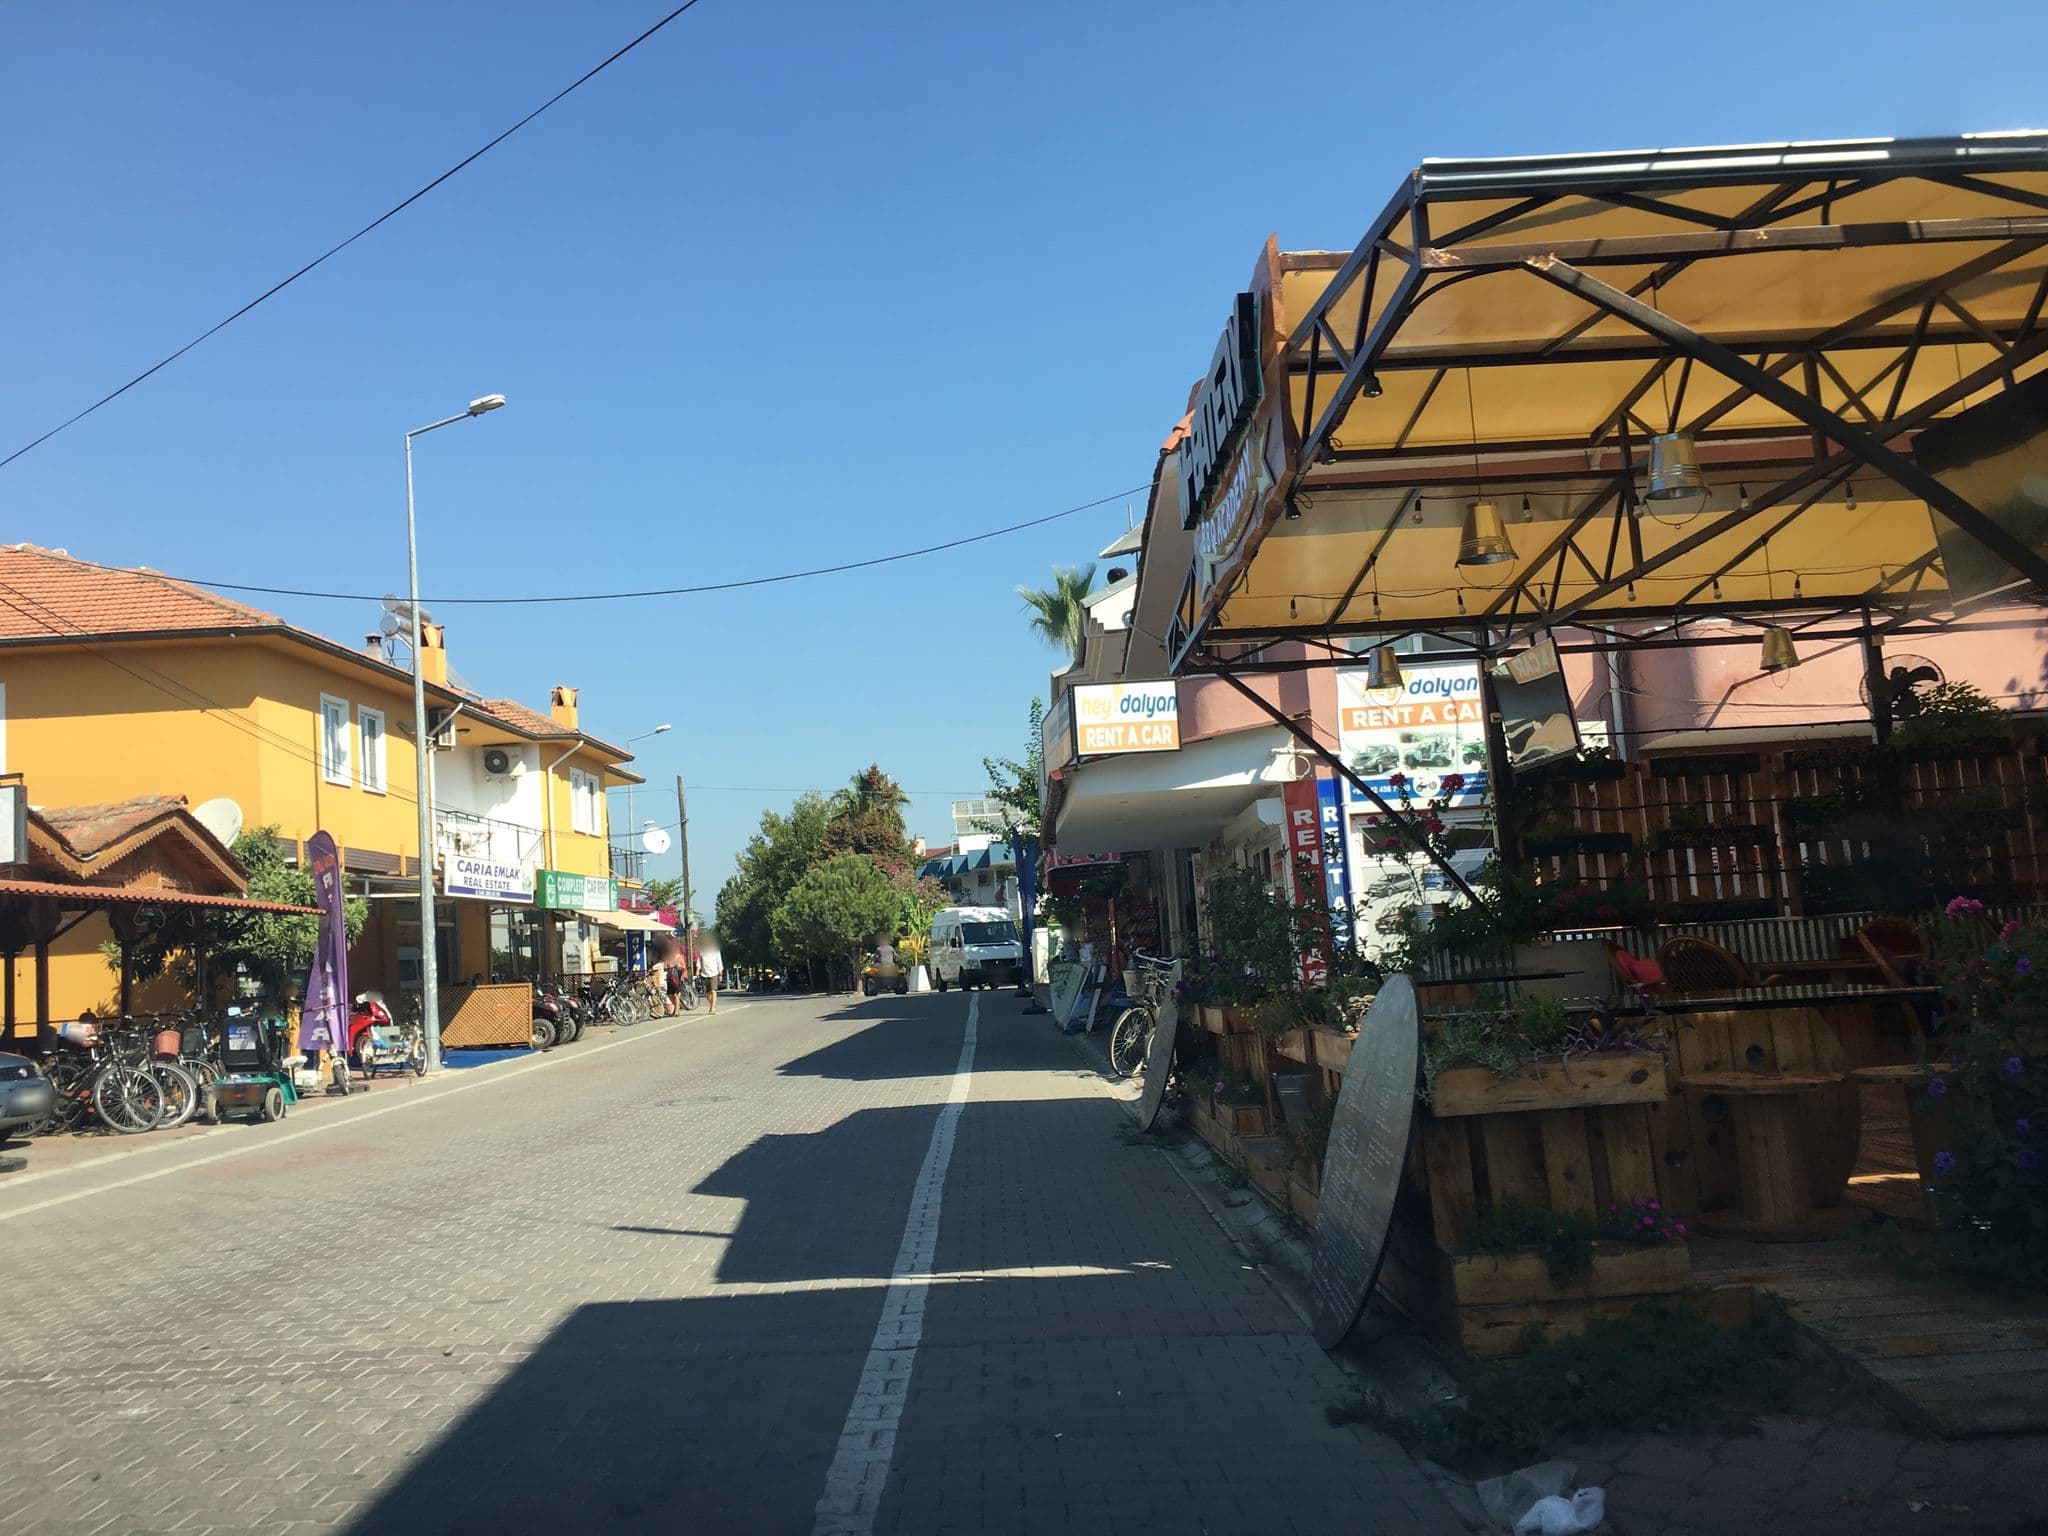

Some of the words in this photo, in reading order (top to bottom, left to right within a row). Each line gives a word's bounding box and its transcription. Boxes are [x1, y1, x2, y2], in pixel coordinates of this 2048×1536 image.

[1408, 676, 1479, 697] dalyan
[1119, 693, 1178, 718] dalyan
[1351, 706, 1414, 728] RENT
[1419, 708, 1438, 723] A
[1086, 726, 1125, 748] RENT
[1127, 727, 1140, 746] A
[1141, 723, 1173, 745] CAR
[457, 860, 492, 877] CARIA
[494, 865, 521, 880] EMLAK
[463, 876, 483, 888] REAL
[485, 879, 510, 891] ESTATE
